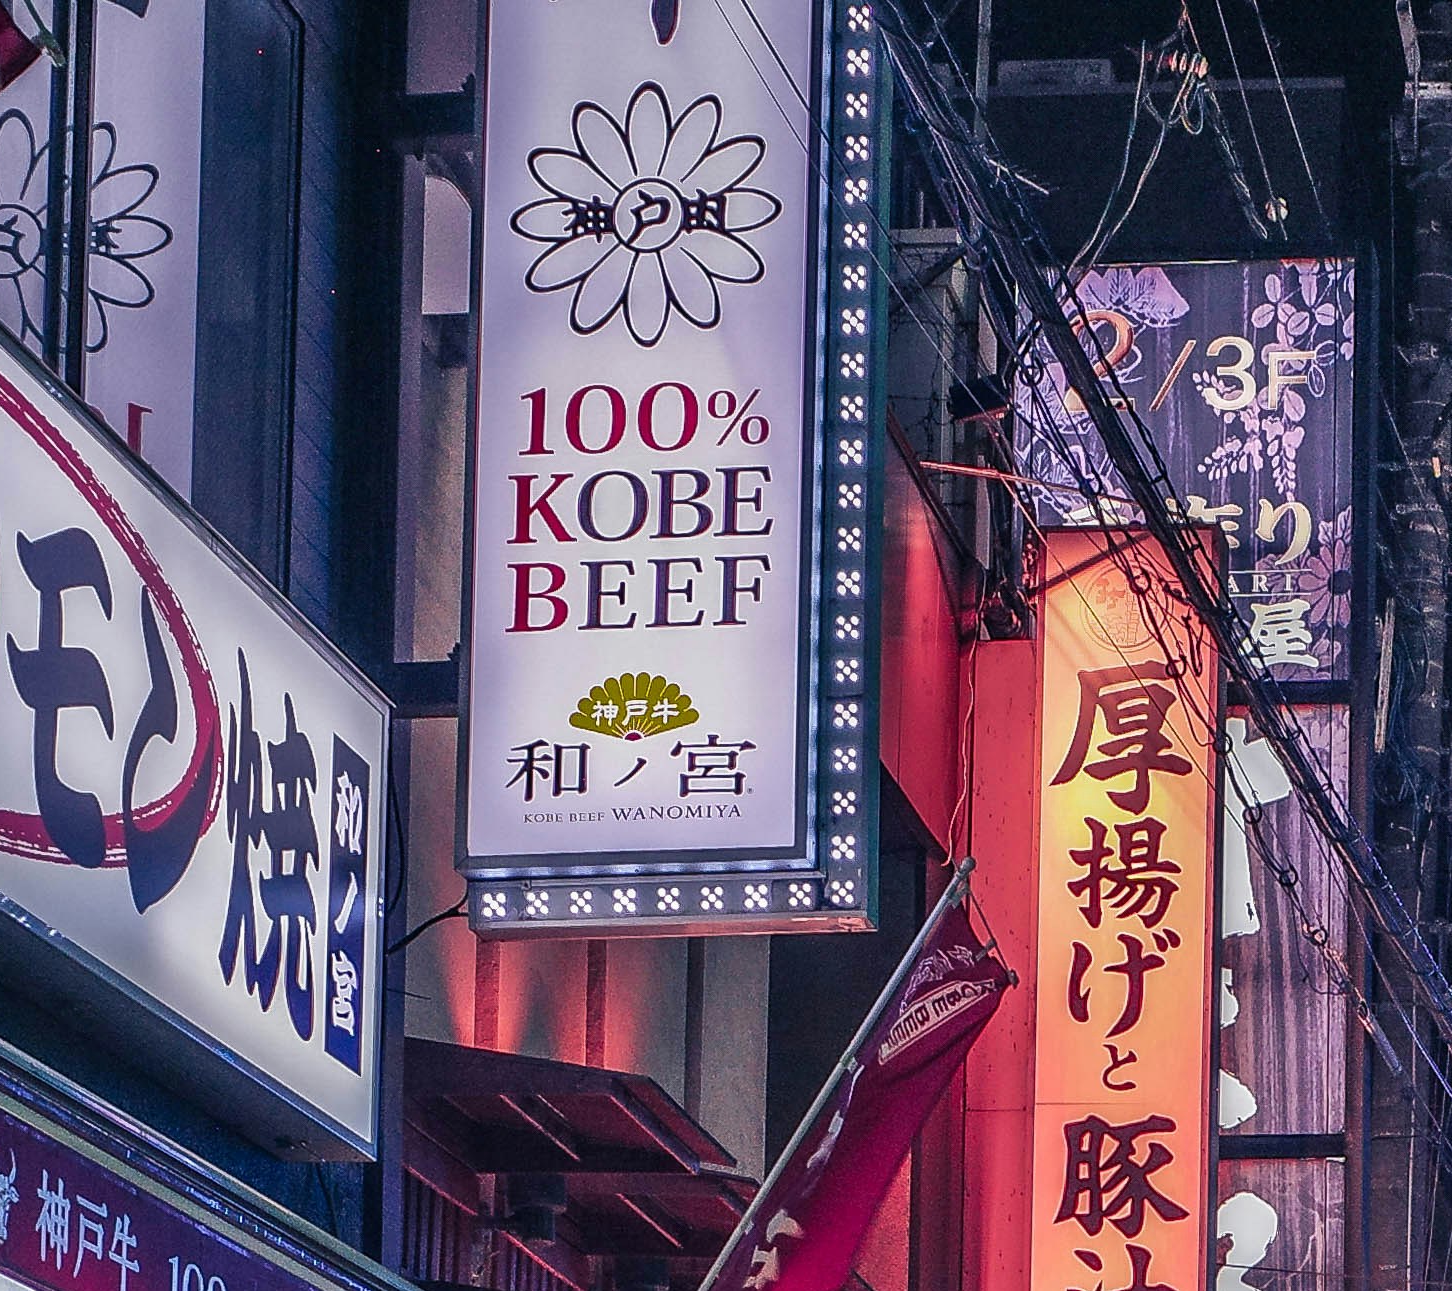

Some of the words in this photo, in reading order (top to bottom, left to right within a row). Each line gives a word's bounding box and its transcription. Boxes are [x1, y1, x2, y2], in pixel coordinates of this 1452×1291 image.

[517, 381, 771, 457] 100%
[505, 466, 775, 545] KOBE
[504, 554, 773, 633] BEEF
[591, 697, 681, 727] 神戸牛
[504, 734, 756, 802] 和ノ宮
[523, 812, 565, 824] KOBE
[569, 811, 605, 823] BEEF
[611, 803, 743, 822] WANOMIYA
